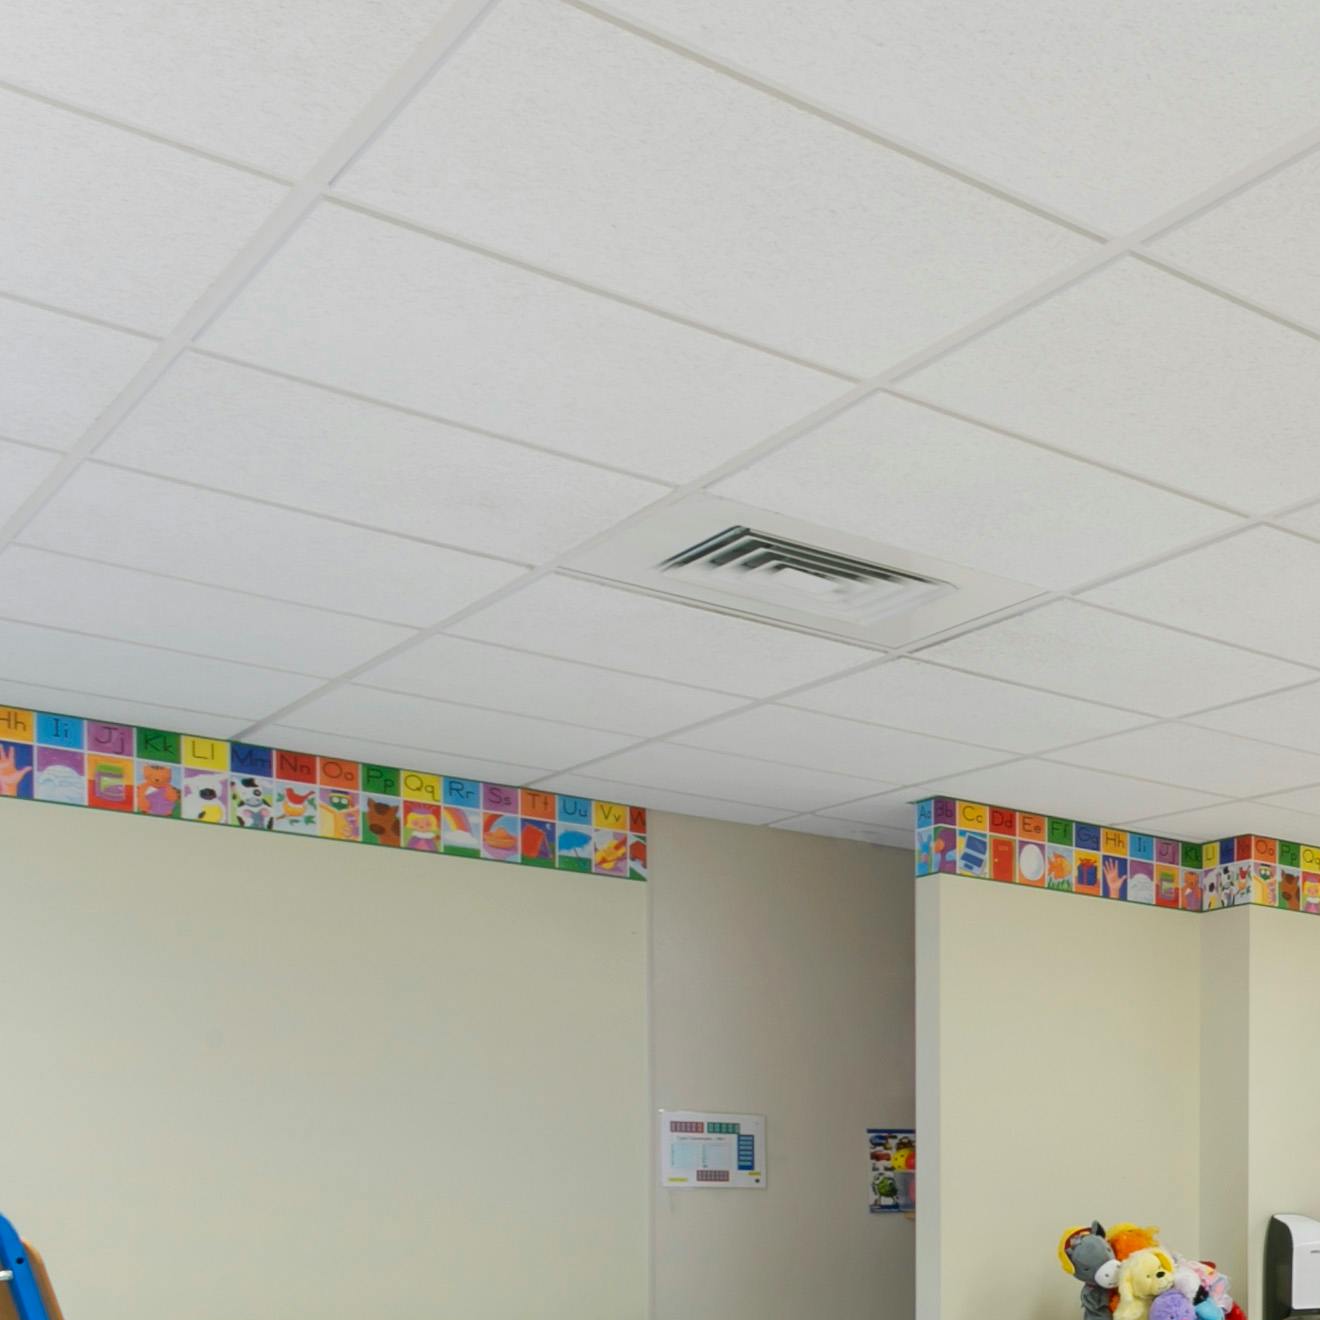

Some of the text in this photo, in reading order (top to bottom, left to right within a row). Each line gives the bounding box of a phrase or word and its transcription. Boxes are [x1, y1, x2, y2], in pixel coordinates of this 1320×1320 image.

[95, 726, 125, 754] Jj
[280, 754, 311, 775] Nn
[322, 761, 354, 781] Oo
[366, 768, 395, 794] Pp
[404, 774, 436, 800] Qq
[449, 781, 475, 800] Rr
[488, 787, 512, 806] Ss
[562, 800, 588, 818] Uu
[601, 807, 622, 823] Vv
[962, 805, 983, 824] Cc
[1022, 816, 1042, 834] Ee
[1105, 831, 1125, 849] Hh
